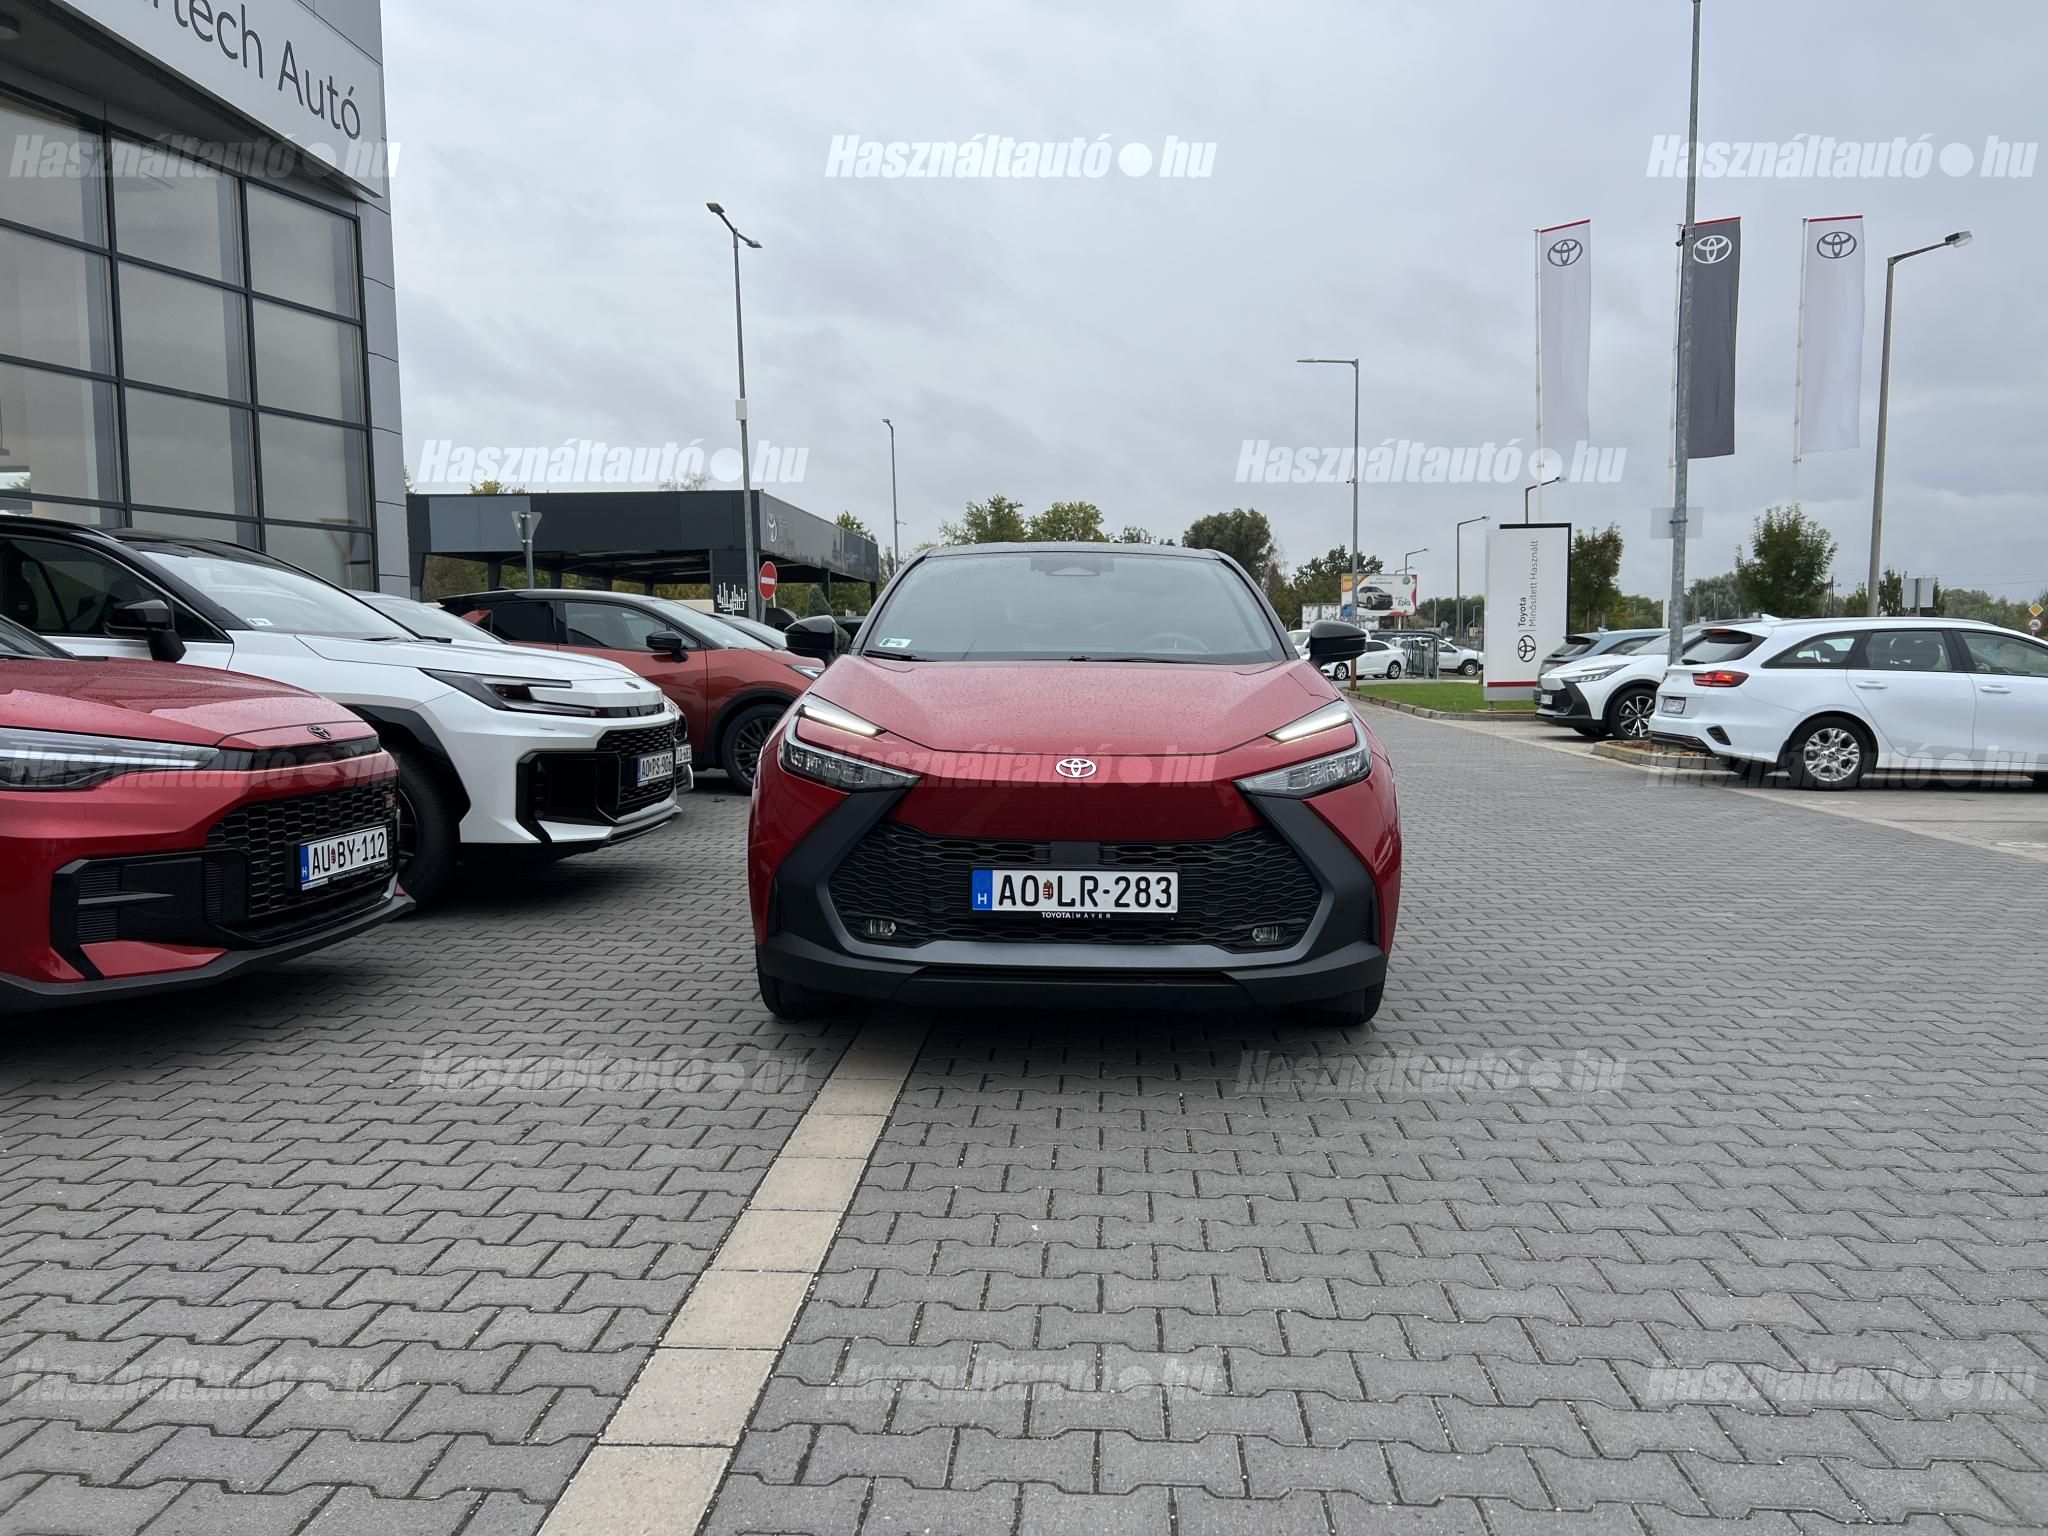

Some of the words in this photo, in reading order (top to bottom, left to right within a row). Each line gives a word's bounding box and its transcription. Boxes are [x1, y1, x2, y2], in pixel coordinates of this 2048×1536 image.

[278, 39, 361, 140] Autó
[1529, 540, 1539, 580] Használt
[1518, 597, 1527, 627] Toyota
[977, 892, 988, 905] H
[1041, 911, 1071, 919] TOYOTA
